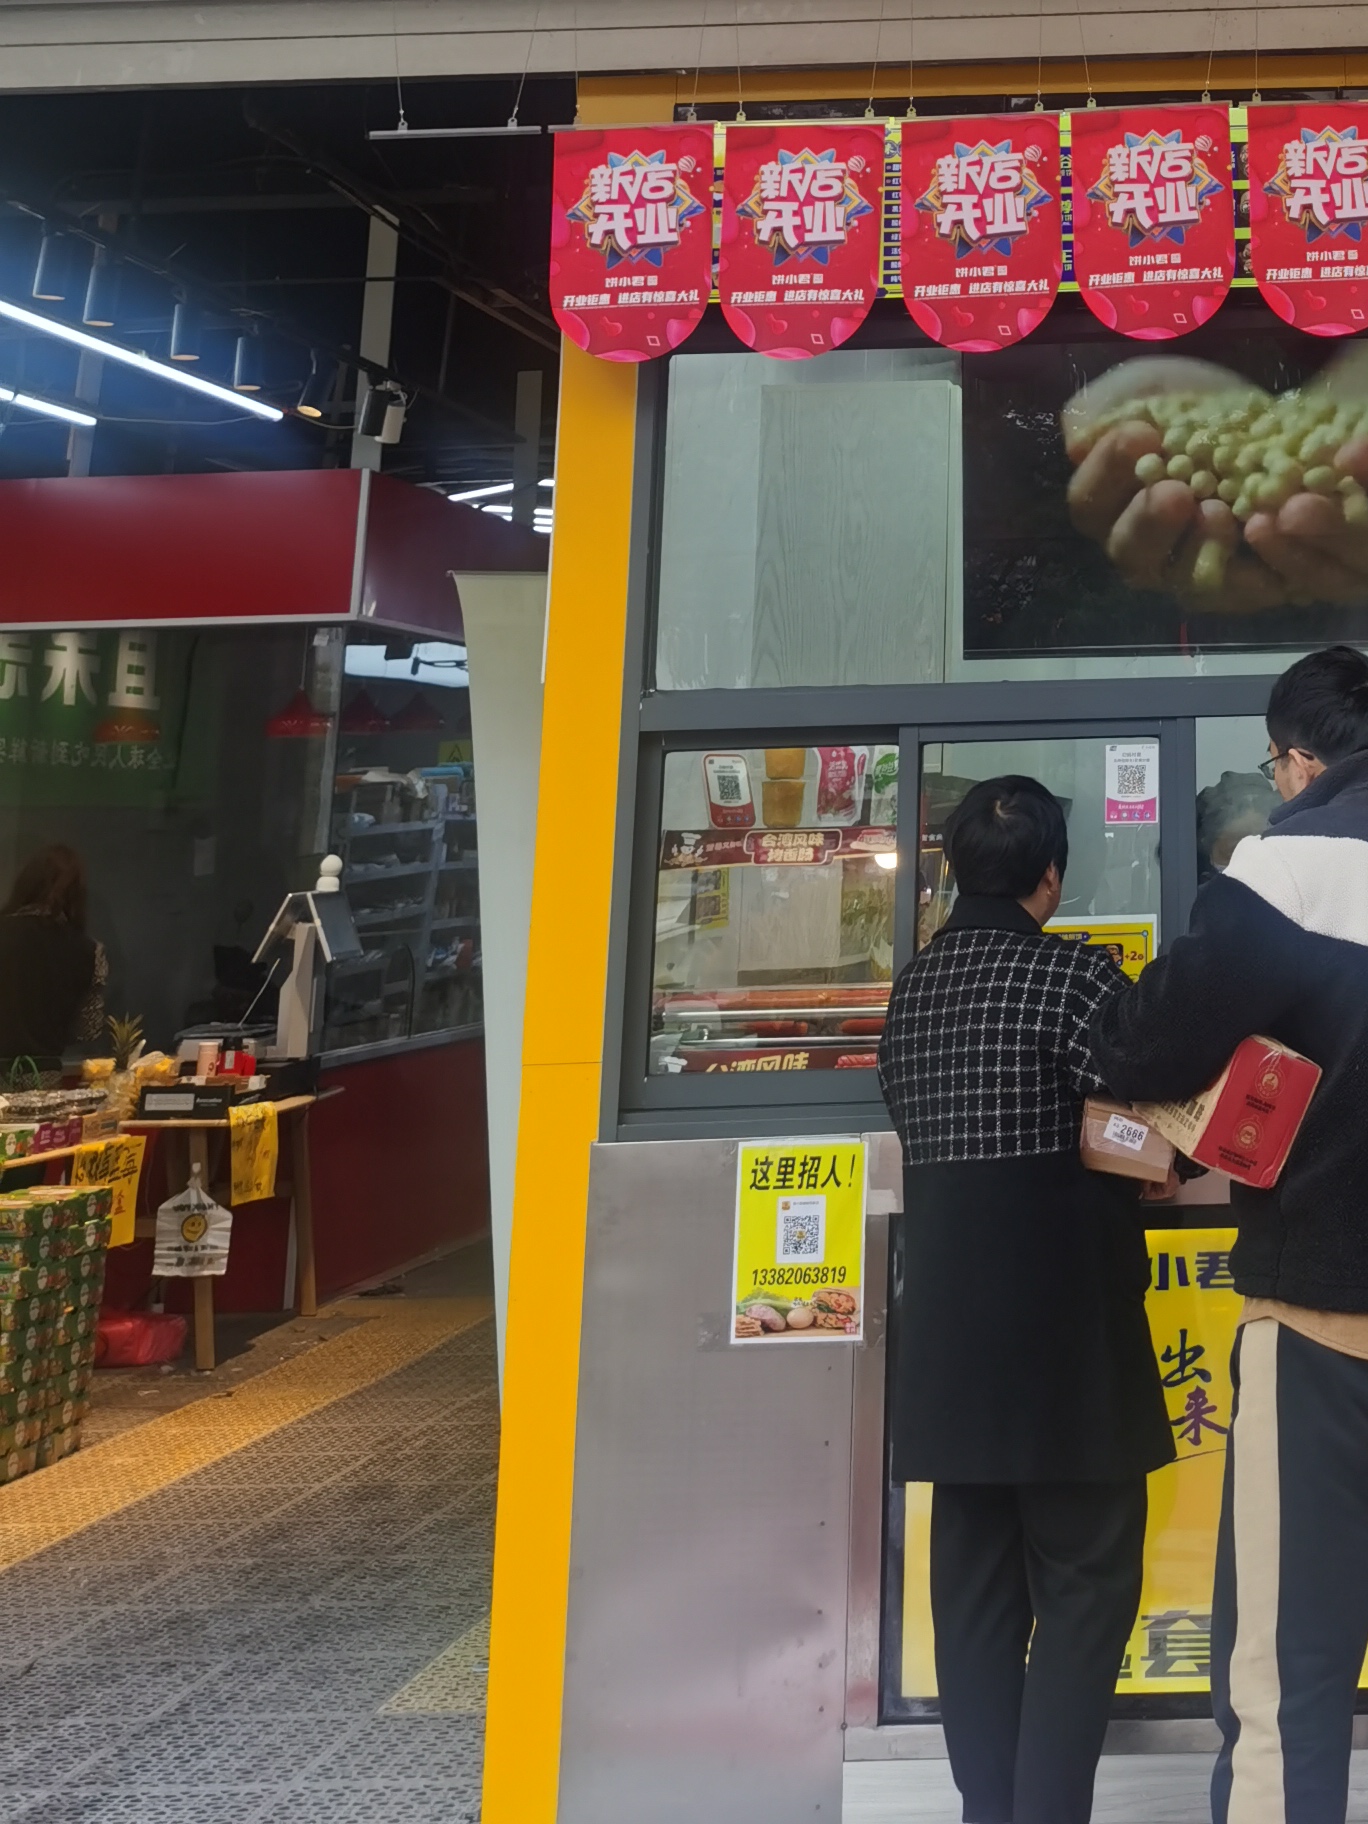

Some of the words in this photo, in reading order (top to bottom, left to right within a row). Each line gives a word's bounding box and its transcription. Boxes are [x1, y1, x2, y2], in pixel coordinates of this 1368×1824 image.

[590, 161, 679, 203] 新店
[760, 162, 849, 202] 新店
[937, 150, 1025, 194] 新店
[1107, 141, 1194, 183] 新店
[587, 201, 680, 251] 开业
[757, 200, 847, 251] 开业
[936, 192, 1027, 241] 开业
[1109, 182, 1200, 230] 开业
[783, 287, 865, 303] 进店有惊喜大礼
[968, 278, 1050, 294] 进店有惊喜大礼
[1142, 267, 1224, 283] 进店有惊喜大礼
[617, 288, 700, 304] 进店有惊喜大礼
[761, 833, 825, 847] 台湾风味
[1120, 1124, 1145, 1141] 2666
[752, 1266, 847, 1286] 13382063819
